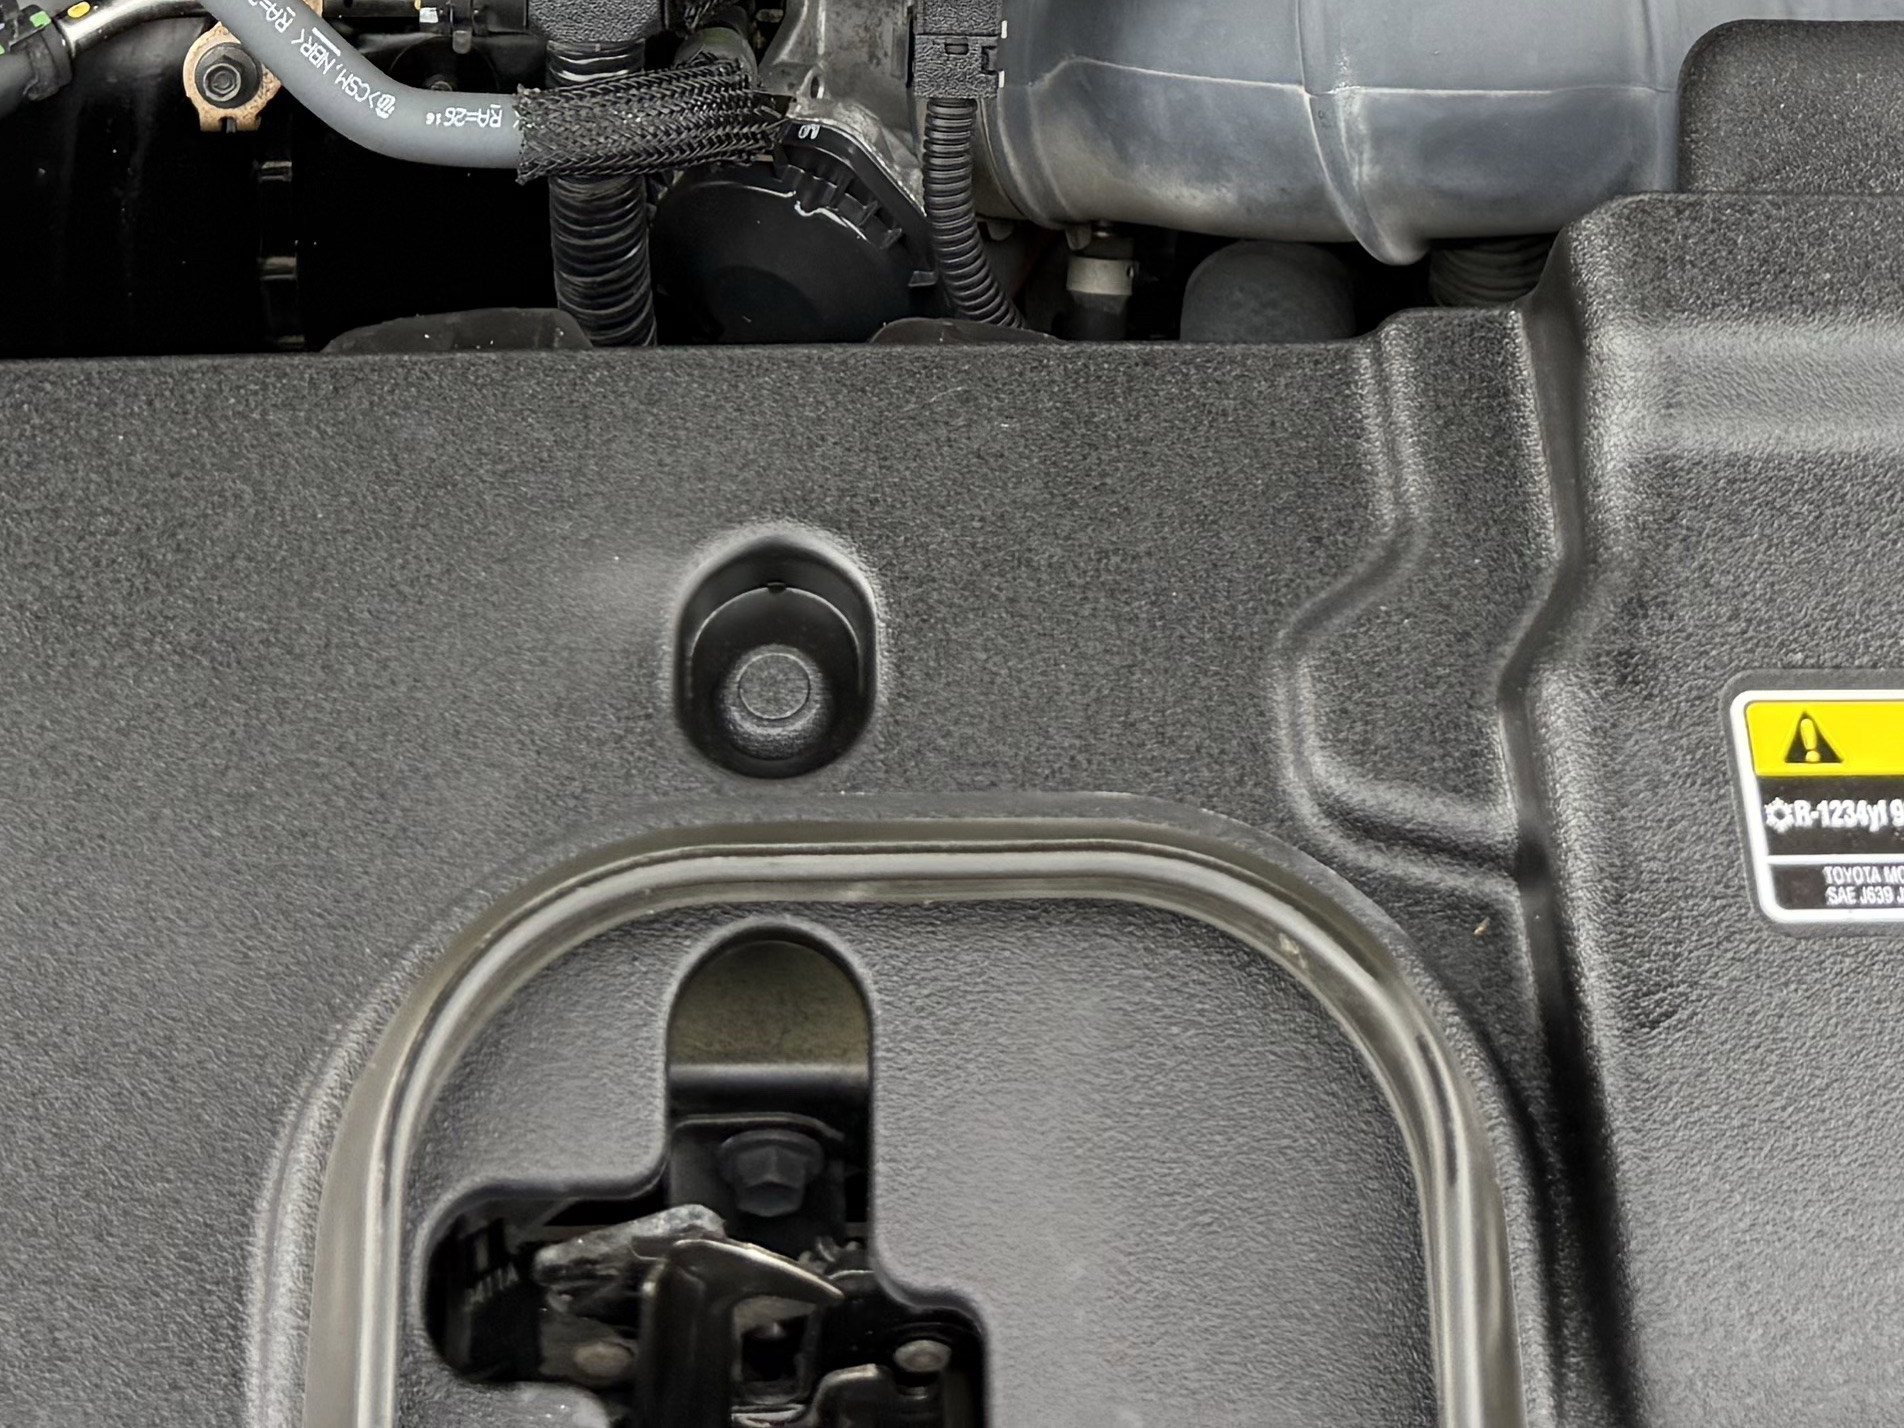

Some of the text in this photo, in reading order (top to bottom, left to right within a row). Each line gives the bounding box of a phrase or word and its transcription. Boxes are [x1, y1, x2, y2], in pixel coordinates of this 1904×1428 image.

[1822, 866, 1881, 885] TOYOTA
[1825, 886, 1857, 905] SAE
[1859, 886, 1895, 905] J639
